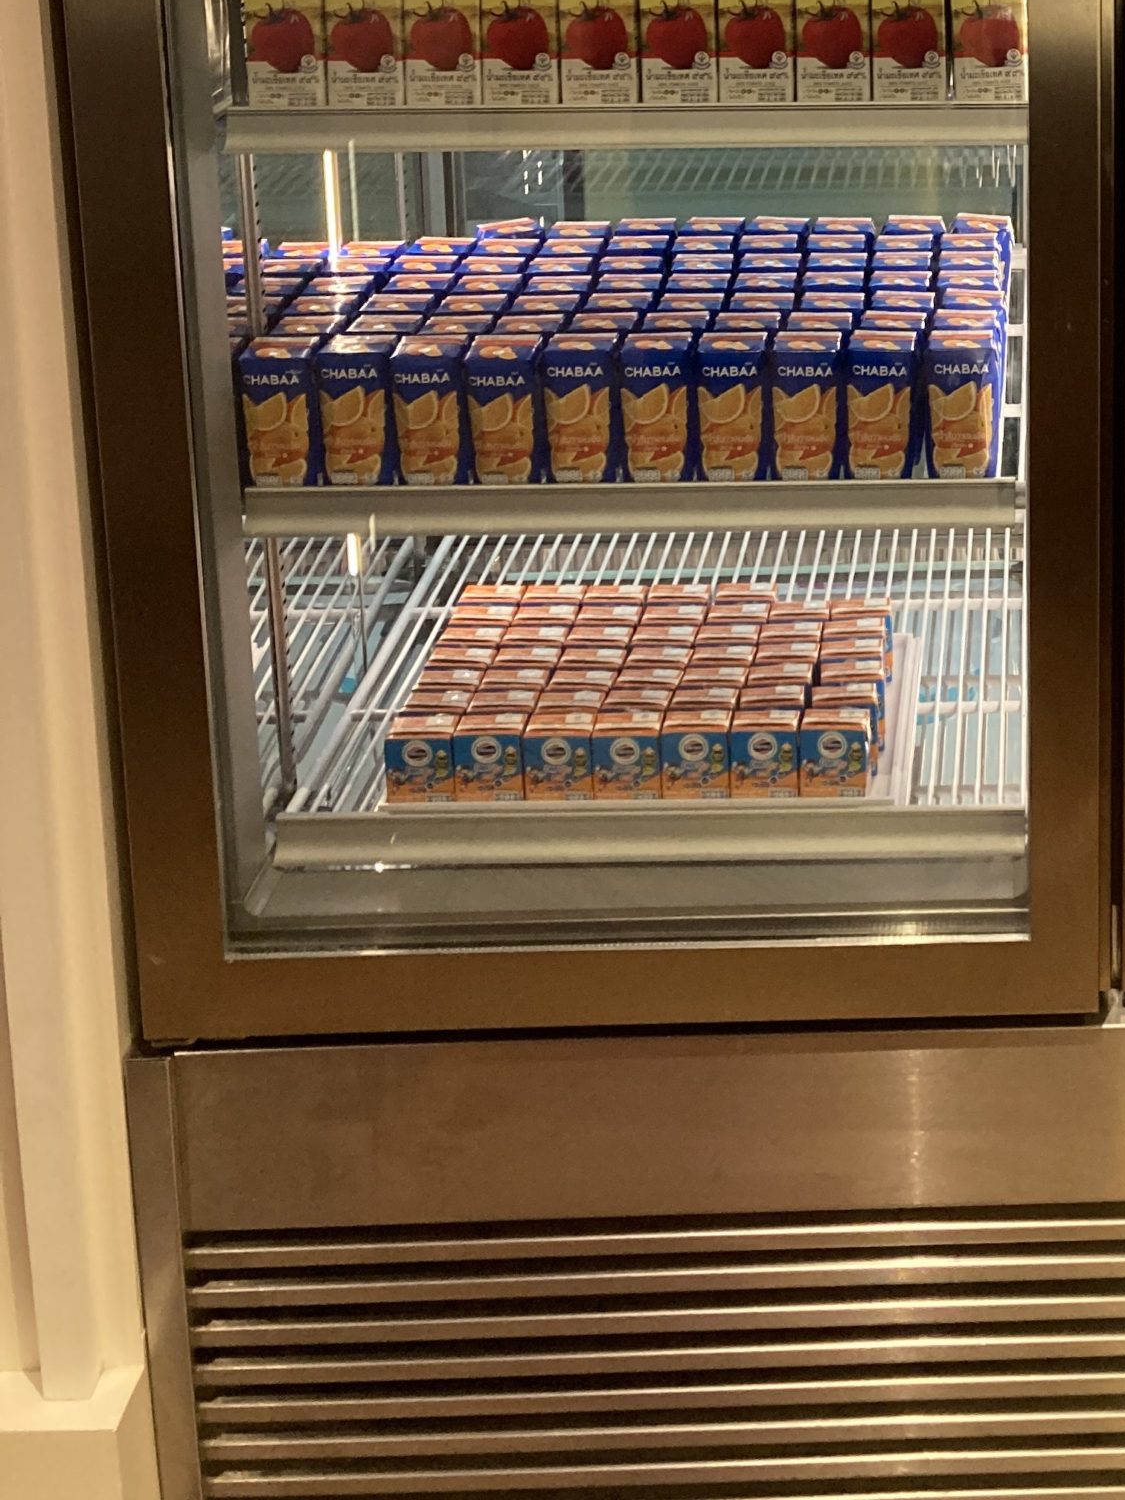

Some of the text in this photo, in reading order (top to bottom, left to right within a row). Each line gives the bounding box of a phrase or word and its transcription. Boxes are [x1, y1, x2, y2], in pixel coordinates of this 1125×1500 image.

[321, 367, 378, 380] CHABAA
[547, 366, 604, 379] CHABAA
[624, 365, 681, 378] CHABAA
[702, 365, 758, 378] CHABAA
[778, 365, 834, 377] CHABAA
[852, 364, 907, 376] CHABAA
[934, 362, 989, 375] CHABAA
[243, 373, 300, 386] CHABAA
[395, 371, 450, 384] CHABAA
[468, 375, 525, 388] CHABAA
